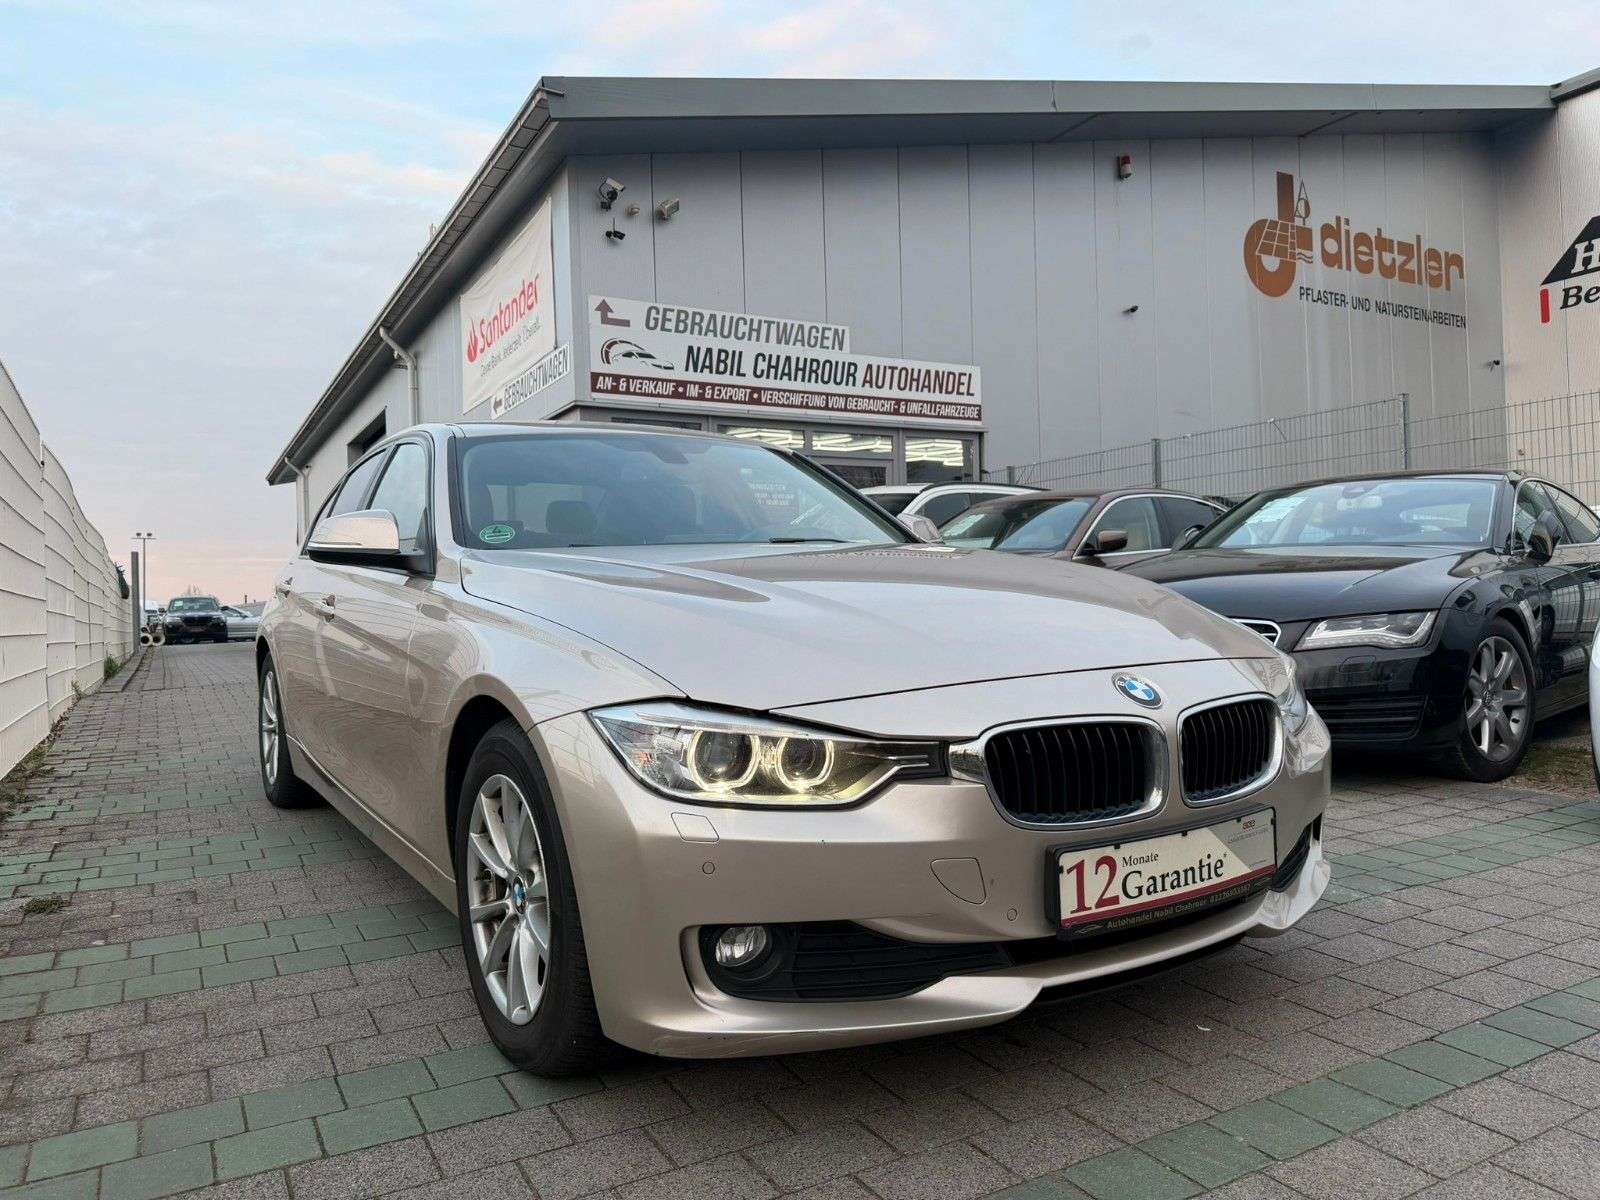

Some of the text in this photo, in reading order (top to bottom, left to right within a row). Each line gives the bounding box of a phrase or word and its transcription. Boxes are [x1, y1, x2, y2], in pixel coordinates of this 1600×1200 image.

[1320, 215, 1464, 291] dietzler
[479, 273, 539, 354] Santander
[645, 305, 846, 352] GEBRAUCHTWAGEN
[1299, 286, 1467, 329] PFLASTER- UND NATURSTEINARBEITEN
[503, 346, 569, 410] GEBRAUCHTWAGEN
[596, 376, 980, 418] AN- & VERKAUF IM- & EXPORT VERSCHIFFUNG VON GEBRAUCHT- & UNFALLFAHRZEUGE
[684, 345, 975, 397] NABIL CHAHROUR AUTOHANDEL
[1066, 855, 1120, 915] 12
[1122, 852, 1159, 867] Monate
